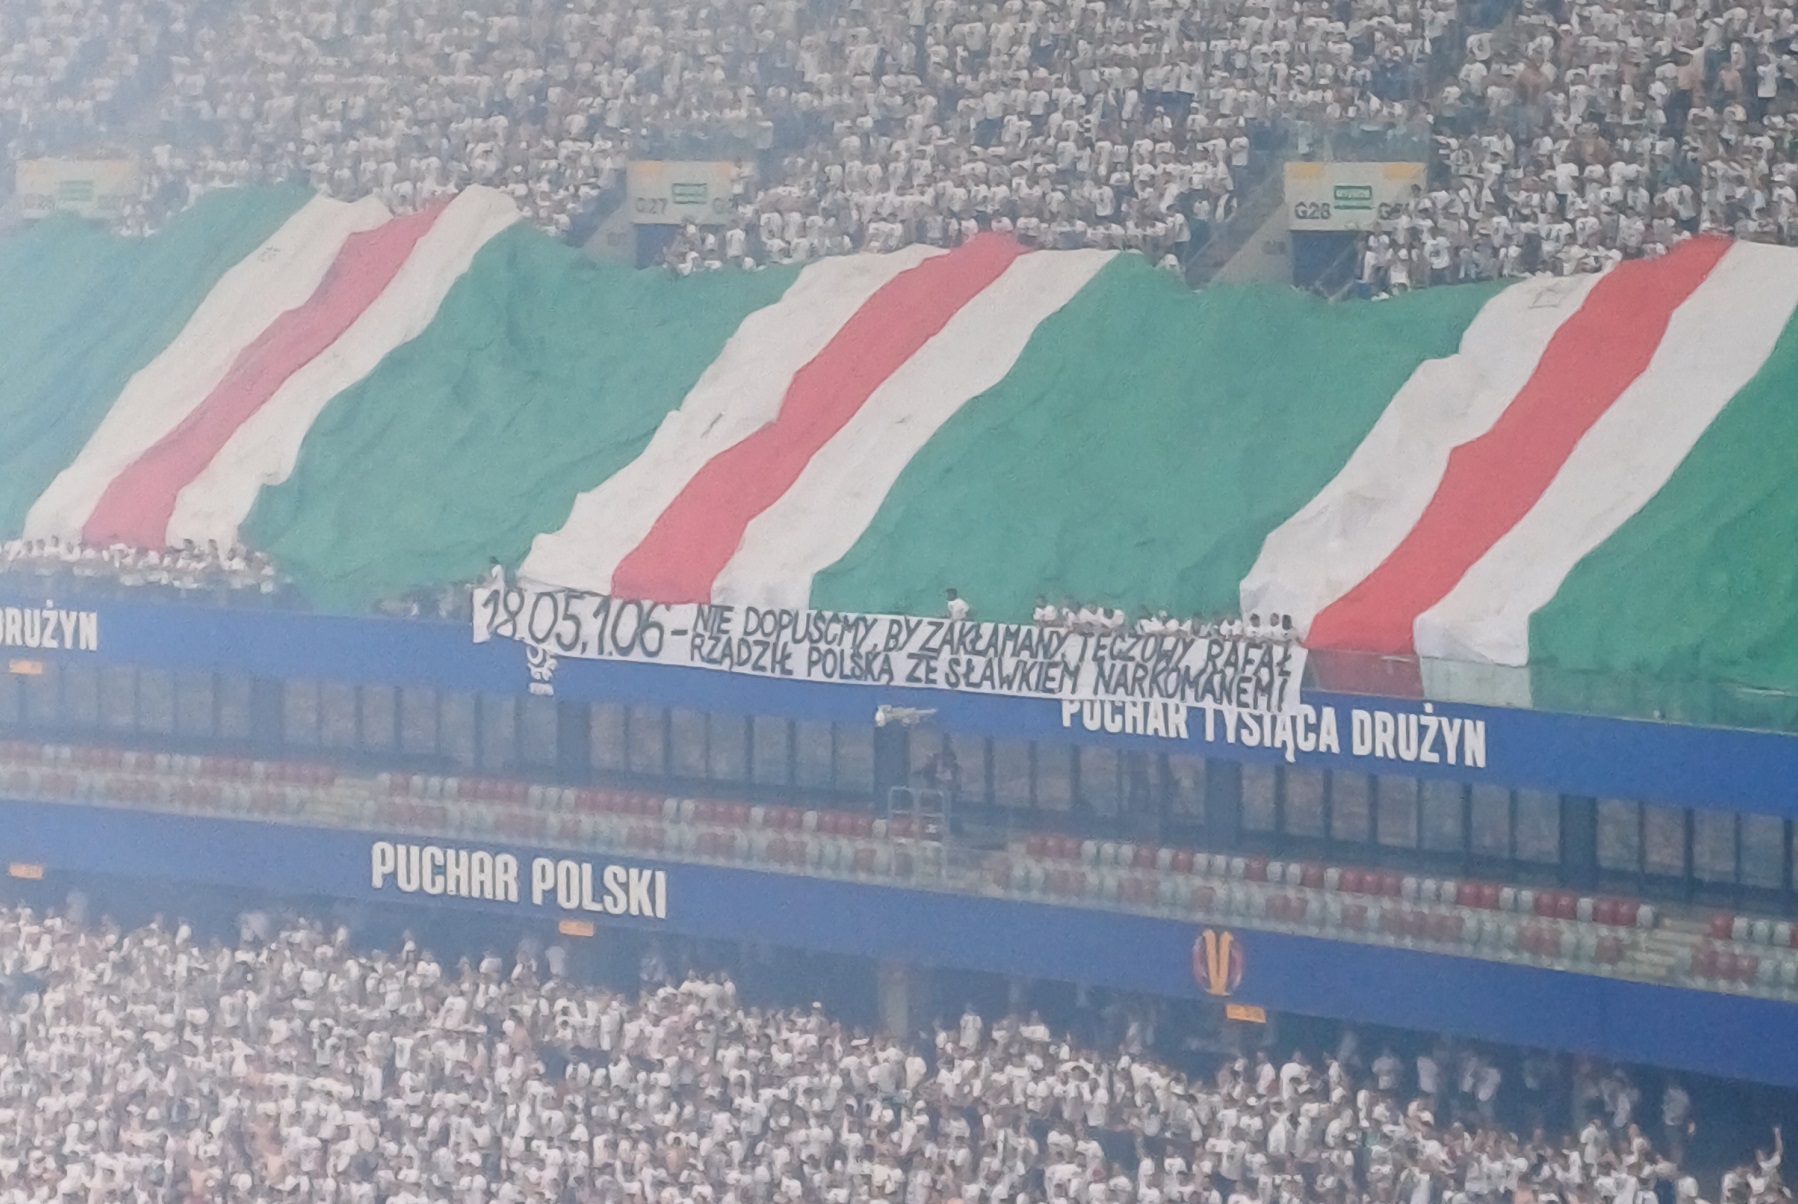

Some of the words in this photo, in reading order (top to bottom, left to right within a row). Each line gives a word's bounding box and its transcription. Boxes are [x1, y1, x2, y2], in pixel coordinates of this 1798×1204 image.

[1294, 201, 1331, 220] G28
[0, 600, 97, 650] RUŻYN
[884, 616, 923, 652] BY
[1205, 638, 1292, 678] RAFAŁ
[906, 652, 938, 685] ZE
[1062, 700, 1189, 739] PUCHAR
[1205, 704, 1340, 763] TYSIĄCA
[1352, 702, 1486, 768] DRUŻYN
[371, 841, 519, 902] PUCHAR
[532, 857, 667, 919] POLSKI
